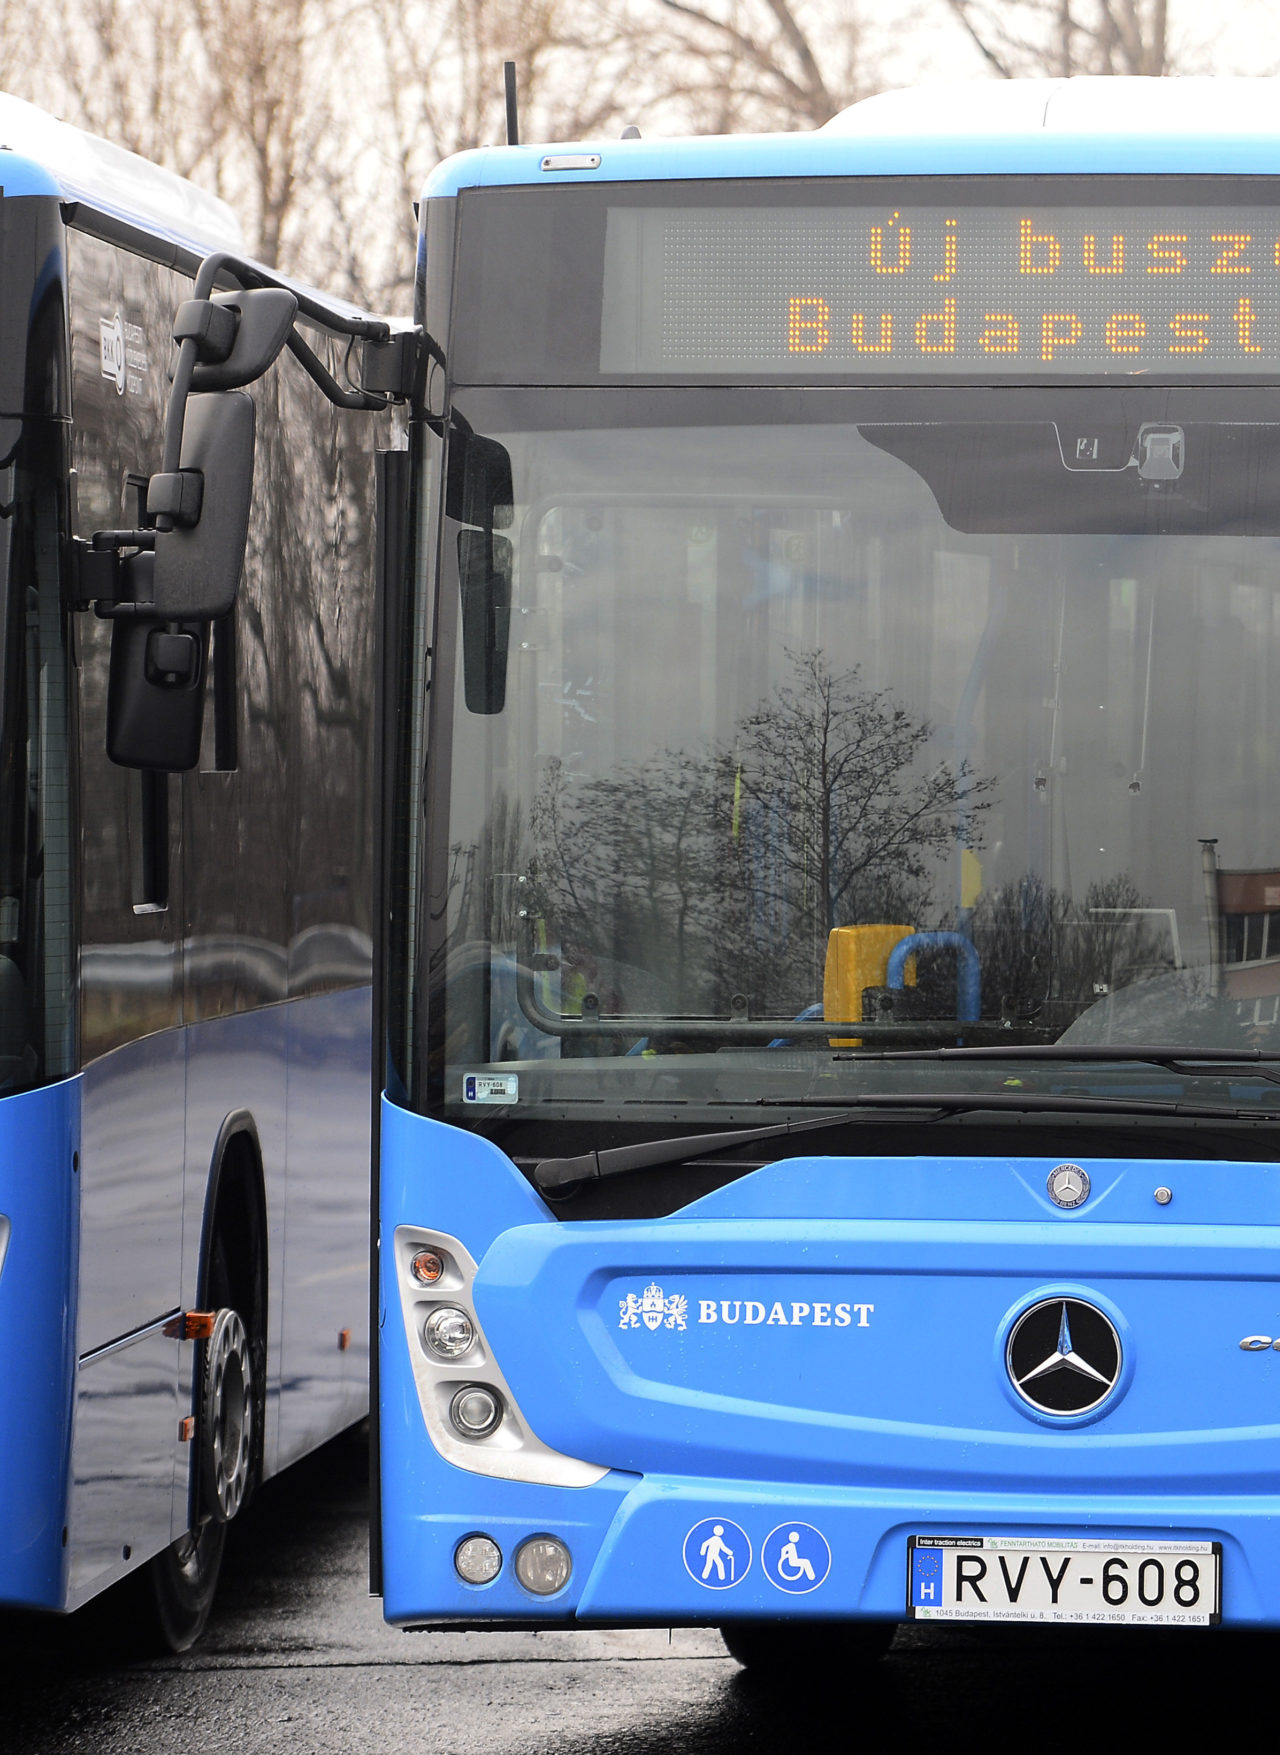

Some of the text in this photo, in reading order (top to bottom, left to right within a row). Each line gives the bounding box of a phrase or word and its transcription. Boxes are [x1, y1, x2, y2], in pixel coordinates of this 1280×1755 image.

[869, 211, 957, 282] Új
[697, 1299, 875, 1327] BUDAPEST
[956, 1539, 981, 1547] electrics
[920, 1582, 935, 1600] H
[955, 1554, 1201, 1608] RVY-608
[936, 1609, 953, 1617] 1045
[1070, 1612, 1083, 1620] +36
[1091, 1613, 1106, 1621] 422
[1108, 1613, 1126, 1621] 1650
[1150, 1614, 1163, 1622] +36
[1171, 1614, 1186, 1622] 422
[1188, 1615, 1205, 1623] 1651
